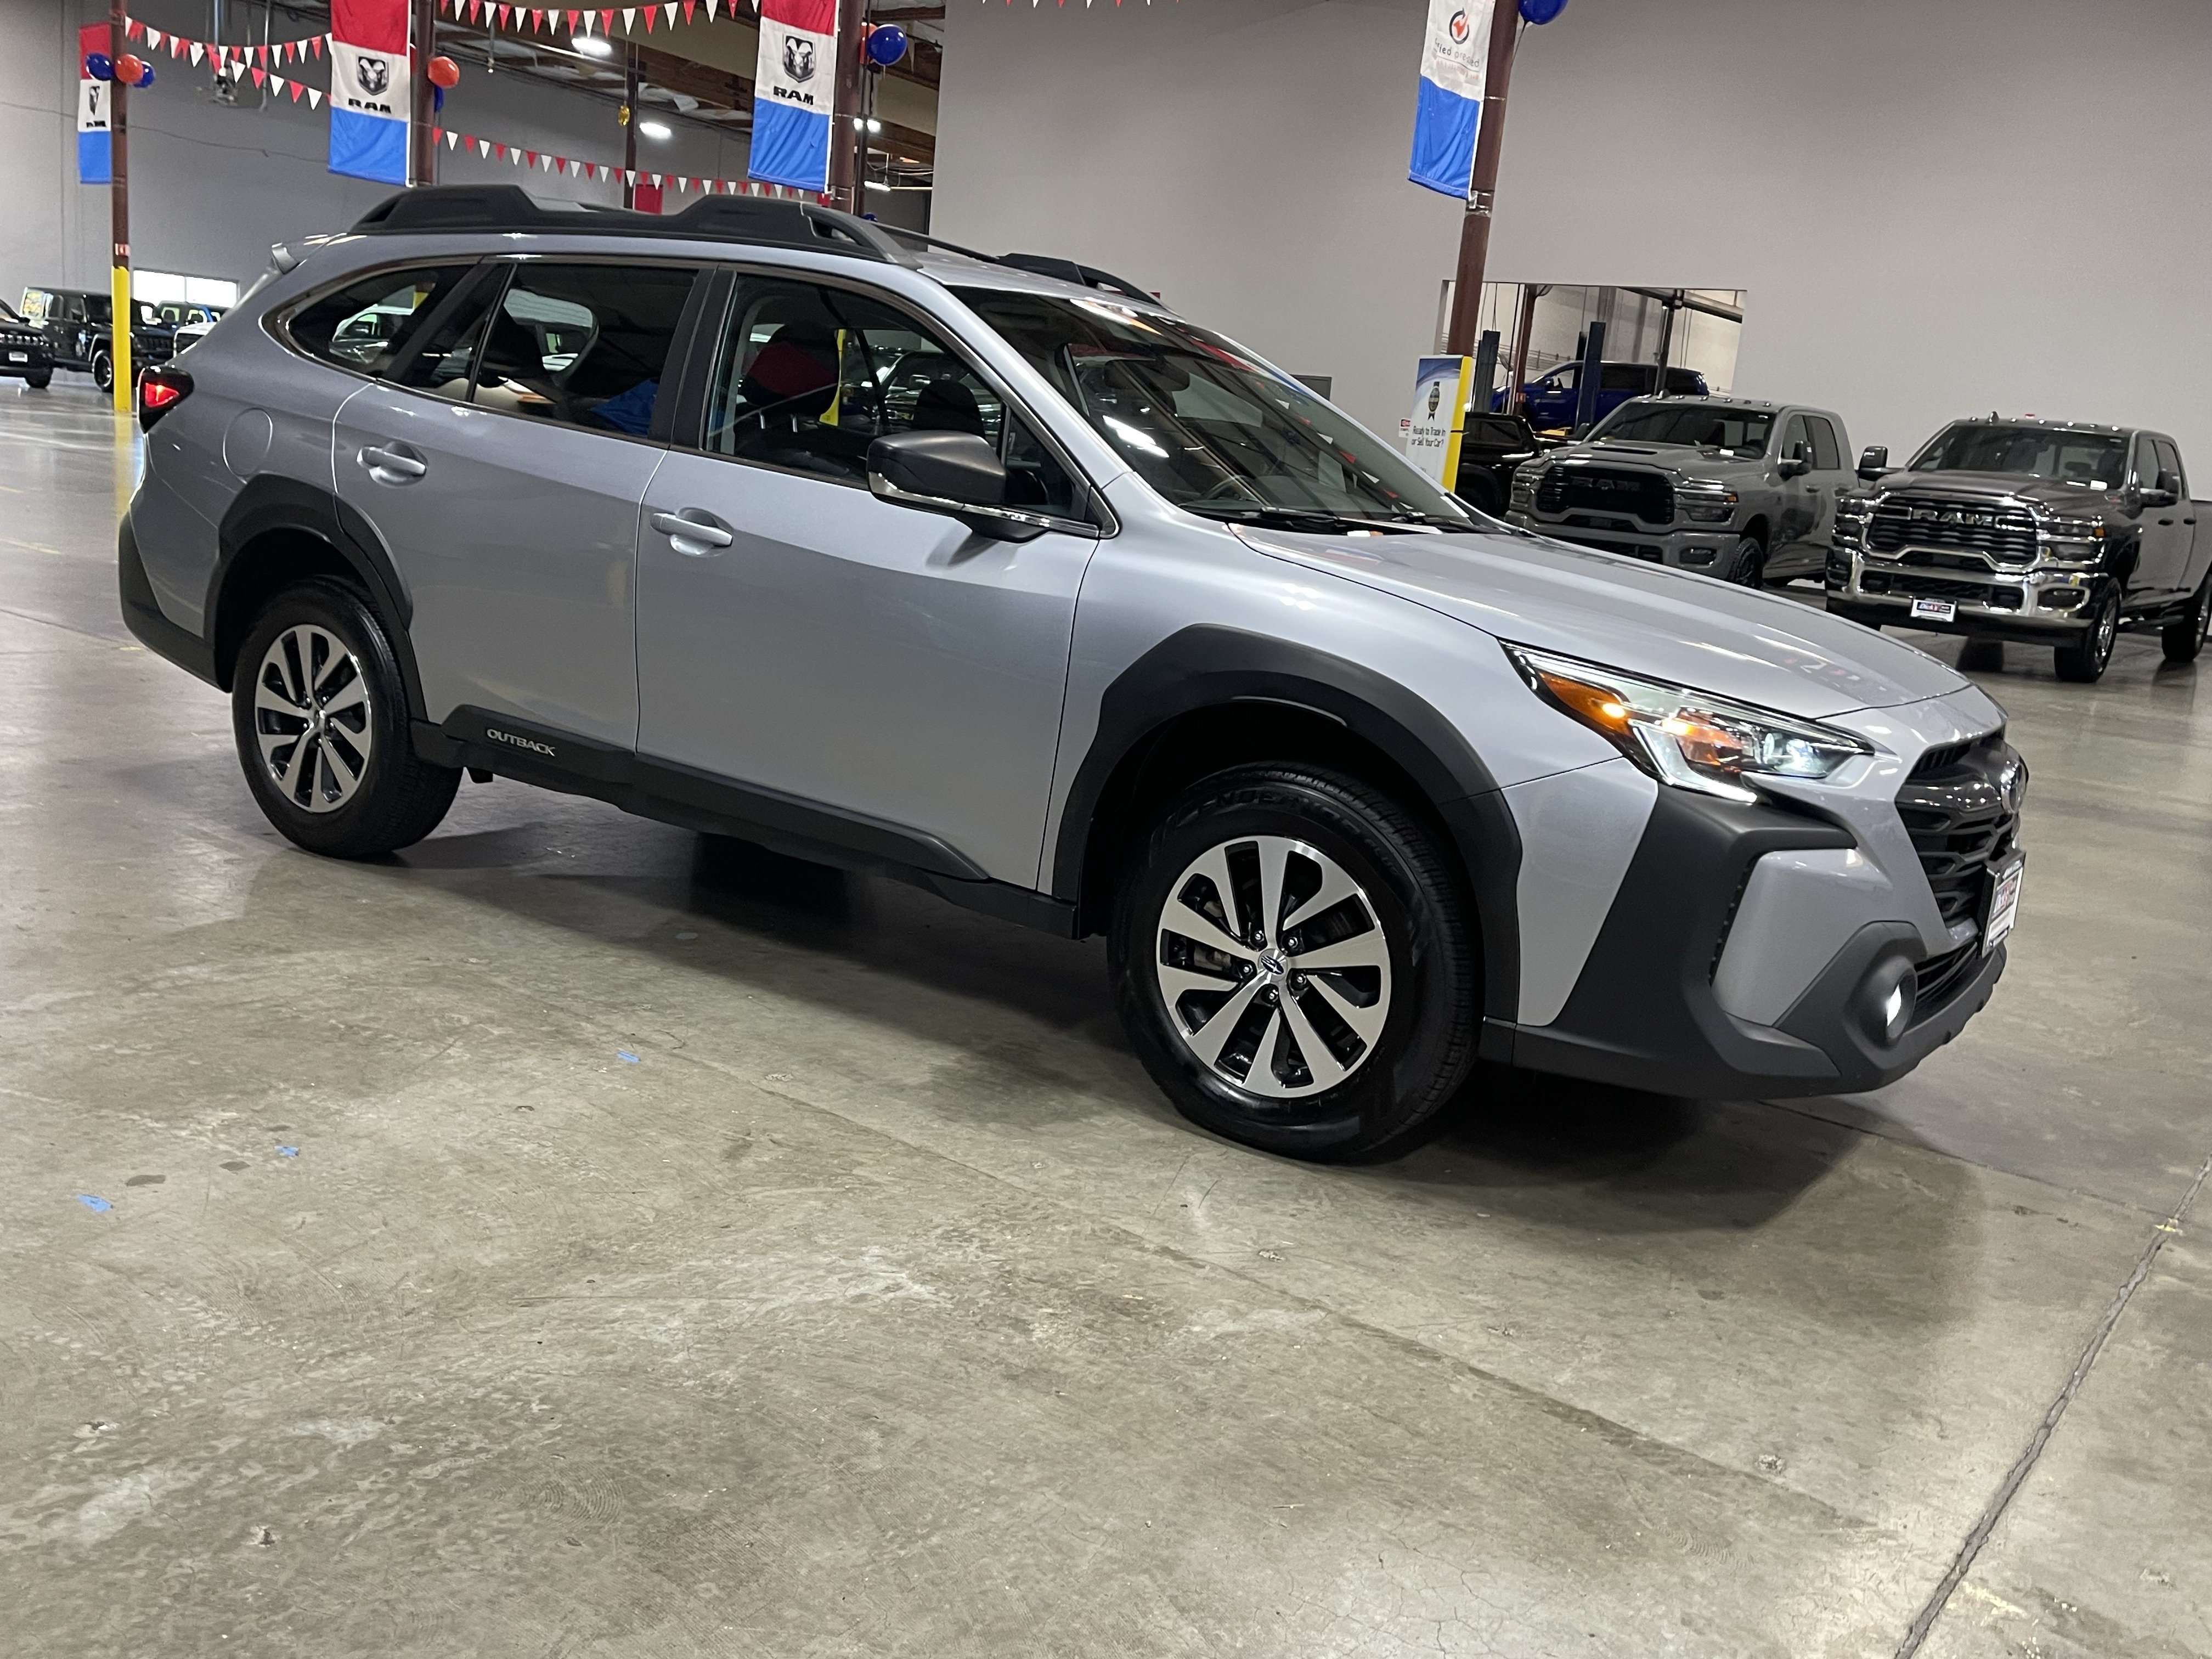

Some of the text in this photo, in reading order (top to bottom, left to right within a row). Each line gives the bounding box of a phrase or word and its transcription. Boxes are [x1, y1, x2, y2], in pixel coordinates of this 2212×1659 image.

[773, 86, 814, 105] RAM
[348, 98, 391, 114] RAM
[1413, 425, 1424, 437] Ready
[1430, 427, 1441, 436] Trade
[1425, 438, 1434, 447] Your
[1912, 509, 1993, 527] RAM
[487, 729, 555, 757] OUTBACK
